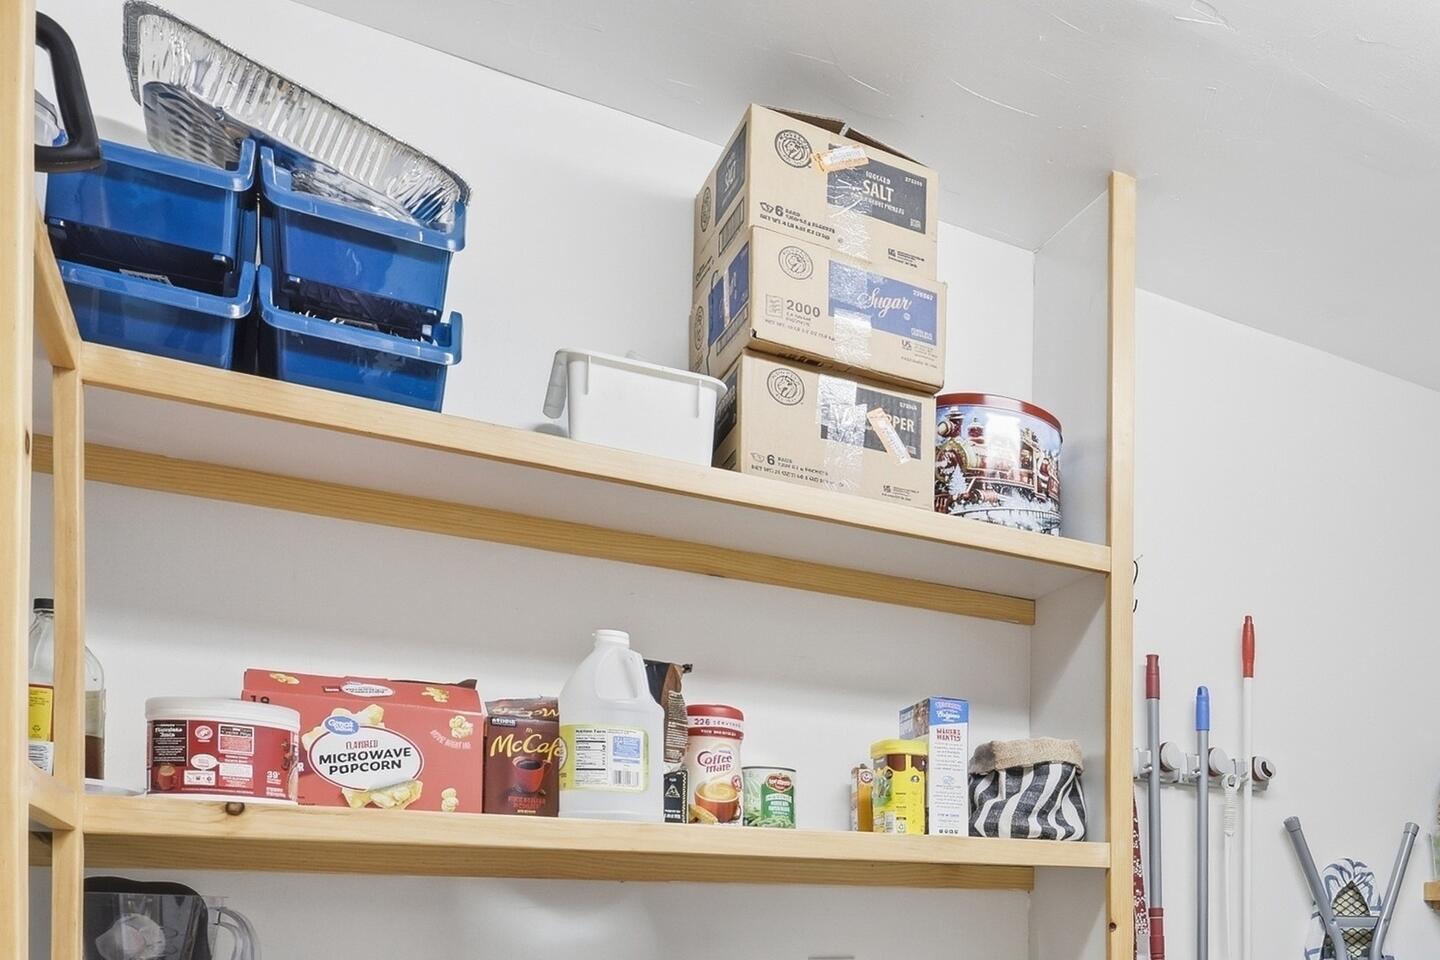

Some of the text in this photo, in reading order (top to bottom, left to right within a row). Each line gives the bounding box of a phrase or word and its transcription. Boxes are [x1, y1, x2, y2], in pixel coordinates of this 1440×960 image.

[862, 179, 894, 202] SALT
[775, 205, 784, 217] 6
[786, 299, 821, 318] 2000
[857, 287, 912, 318] Sugar
[767, 454, 775, 465] 6
[694, 718, 710, 726] 226
[319, 746, 412, 766] MICROWAVE
[697, 751, 732, 767] Coffee
[329, 760, 402, 776] POPCORN
[706, 763, 731, 774] mate
